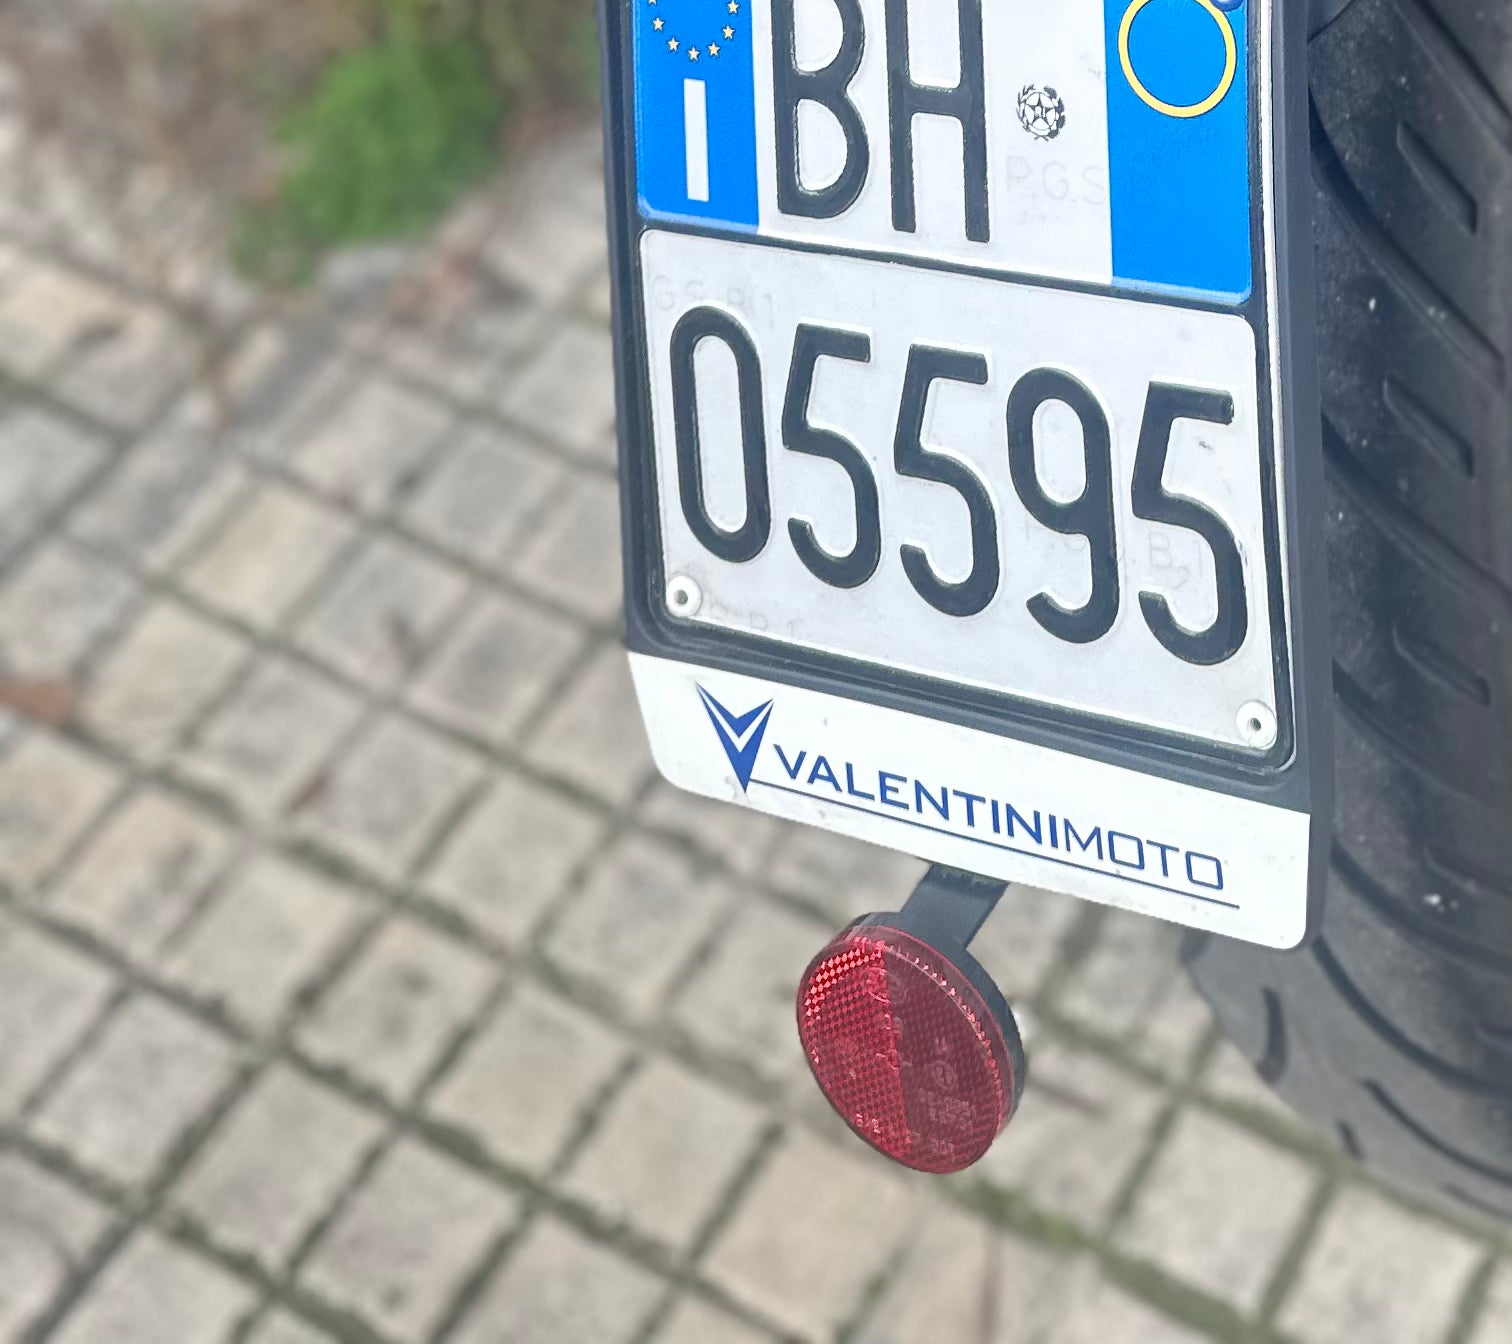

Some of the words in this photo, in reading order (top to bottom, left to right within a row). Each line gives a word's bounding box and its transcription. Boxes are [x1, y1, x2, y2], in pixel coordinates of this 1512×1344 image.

[684, 78, 709, 202] I
[669, 306, 1248, 666] 05595
[773, 743, 1225, 892] VALENTINIMOTO
